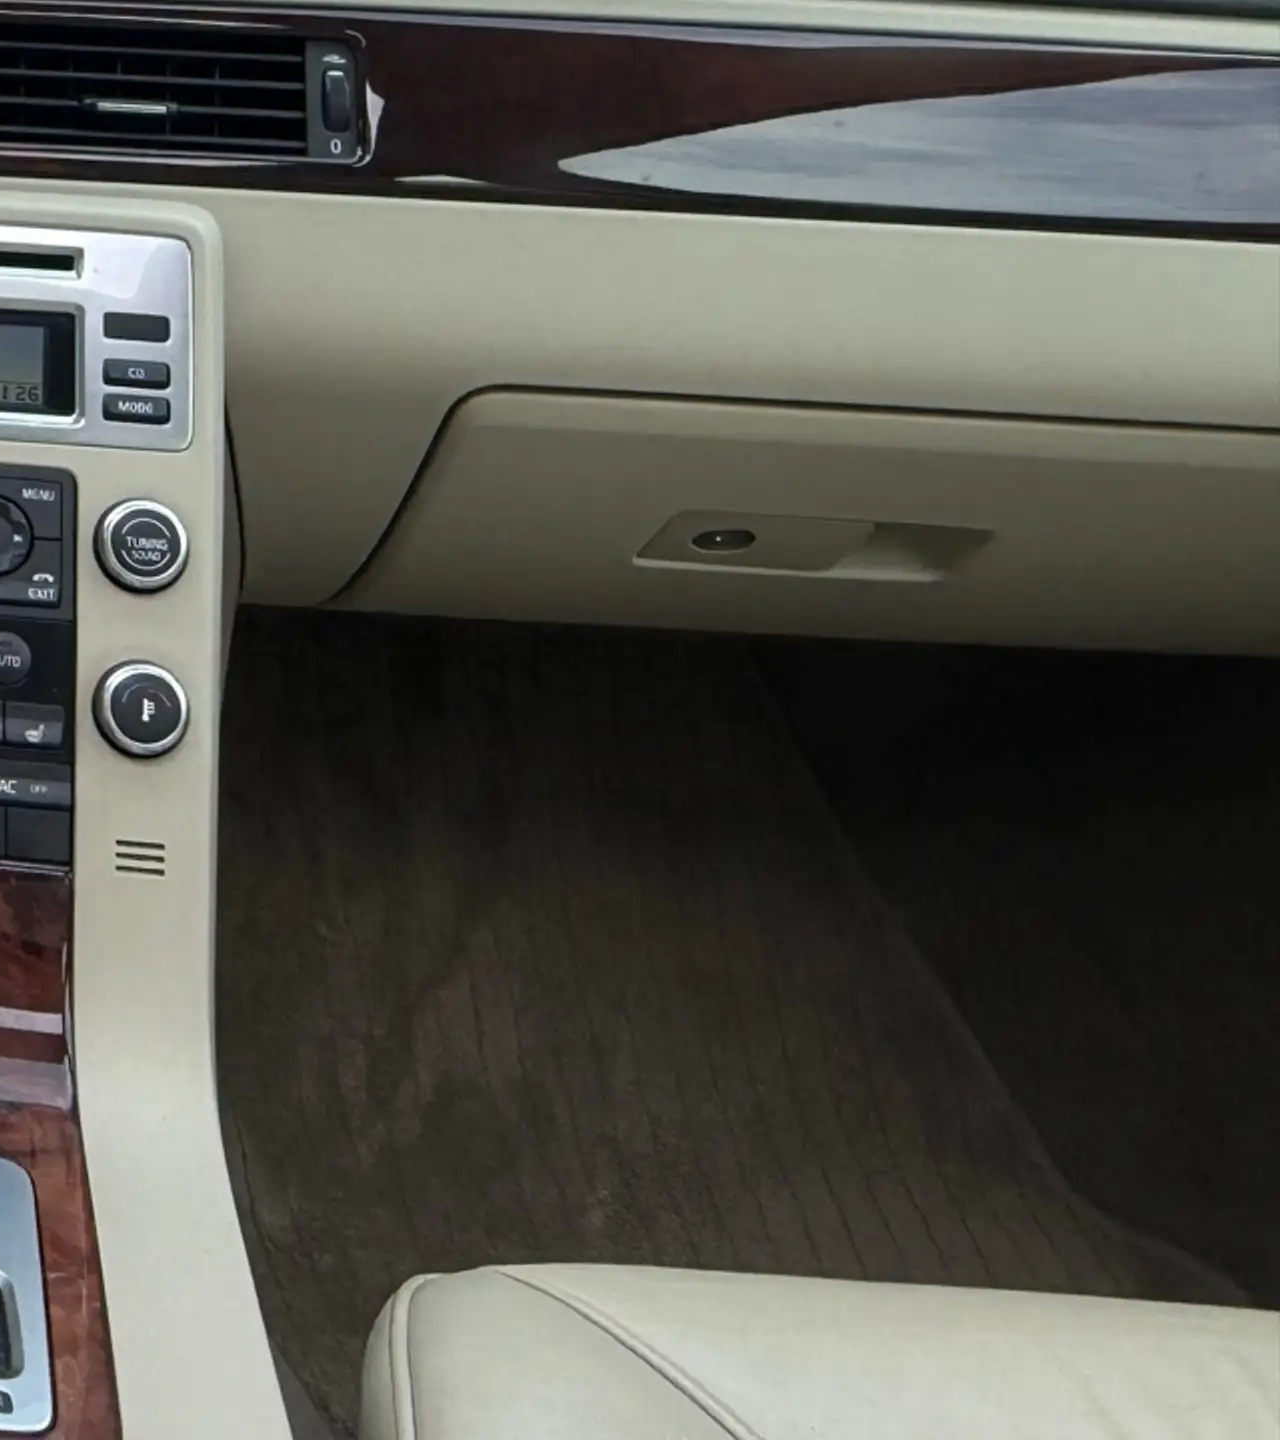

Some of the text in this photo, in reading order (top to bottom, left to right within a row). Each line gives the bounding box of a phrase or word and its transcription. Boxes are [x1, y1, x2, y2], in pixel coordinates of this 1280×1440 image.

[127, 367, 146, 380] CD
[117, 400, 154, 414] MODE
[21, 487, 56, 502] MENU
[125, 535, 169, 550] TUNING
[131, 549, 162, 562] SOUND
[27, 586, 56, 601] EXIT
